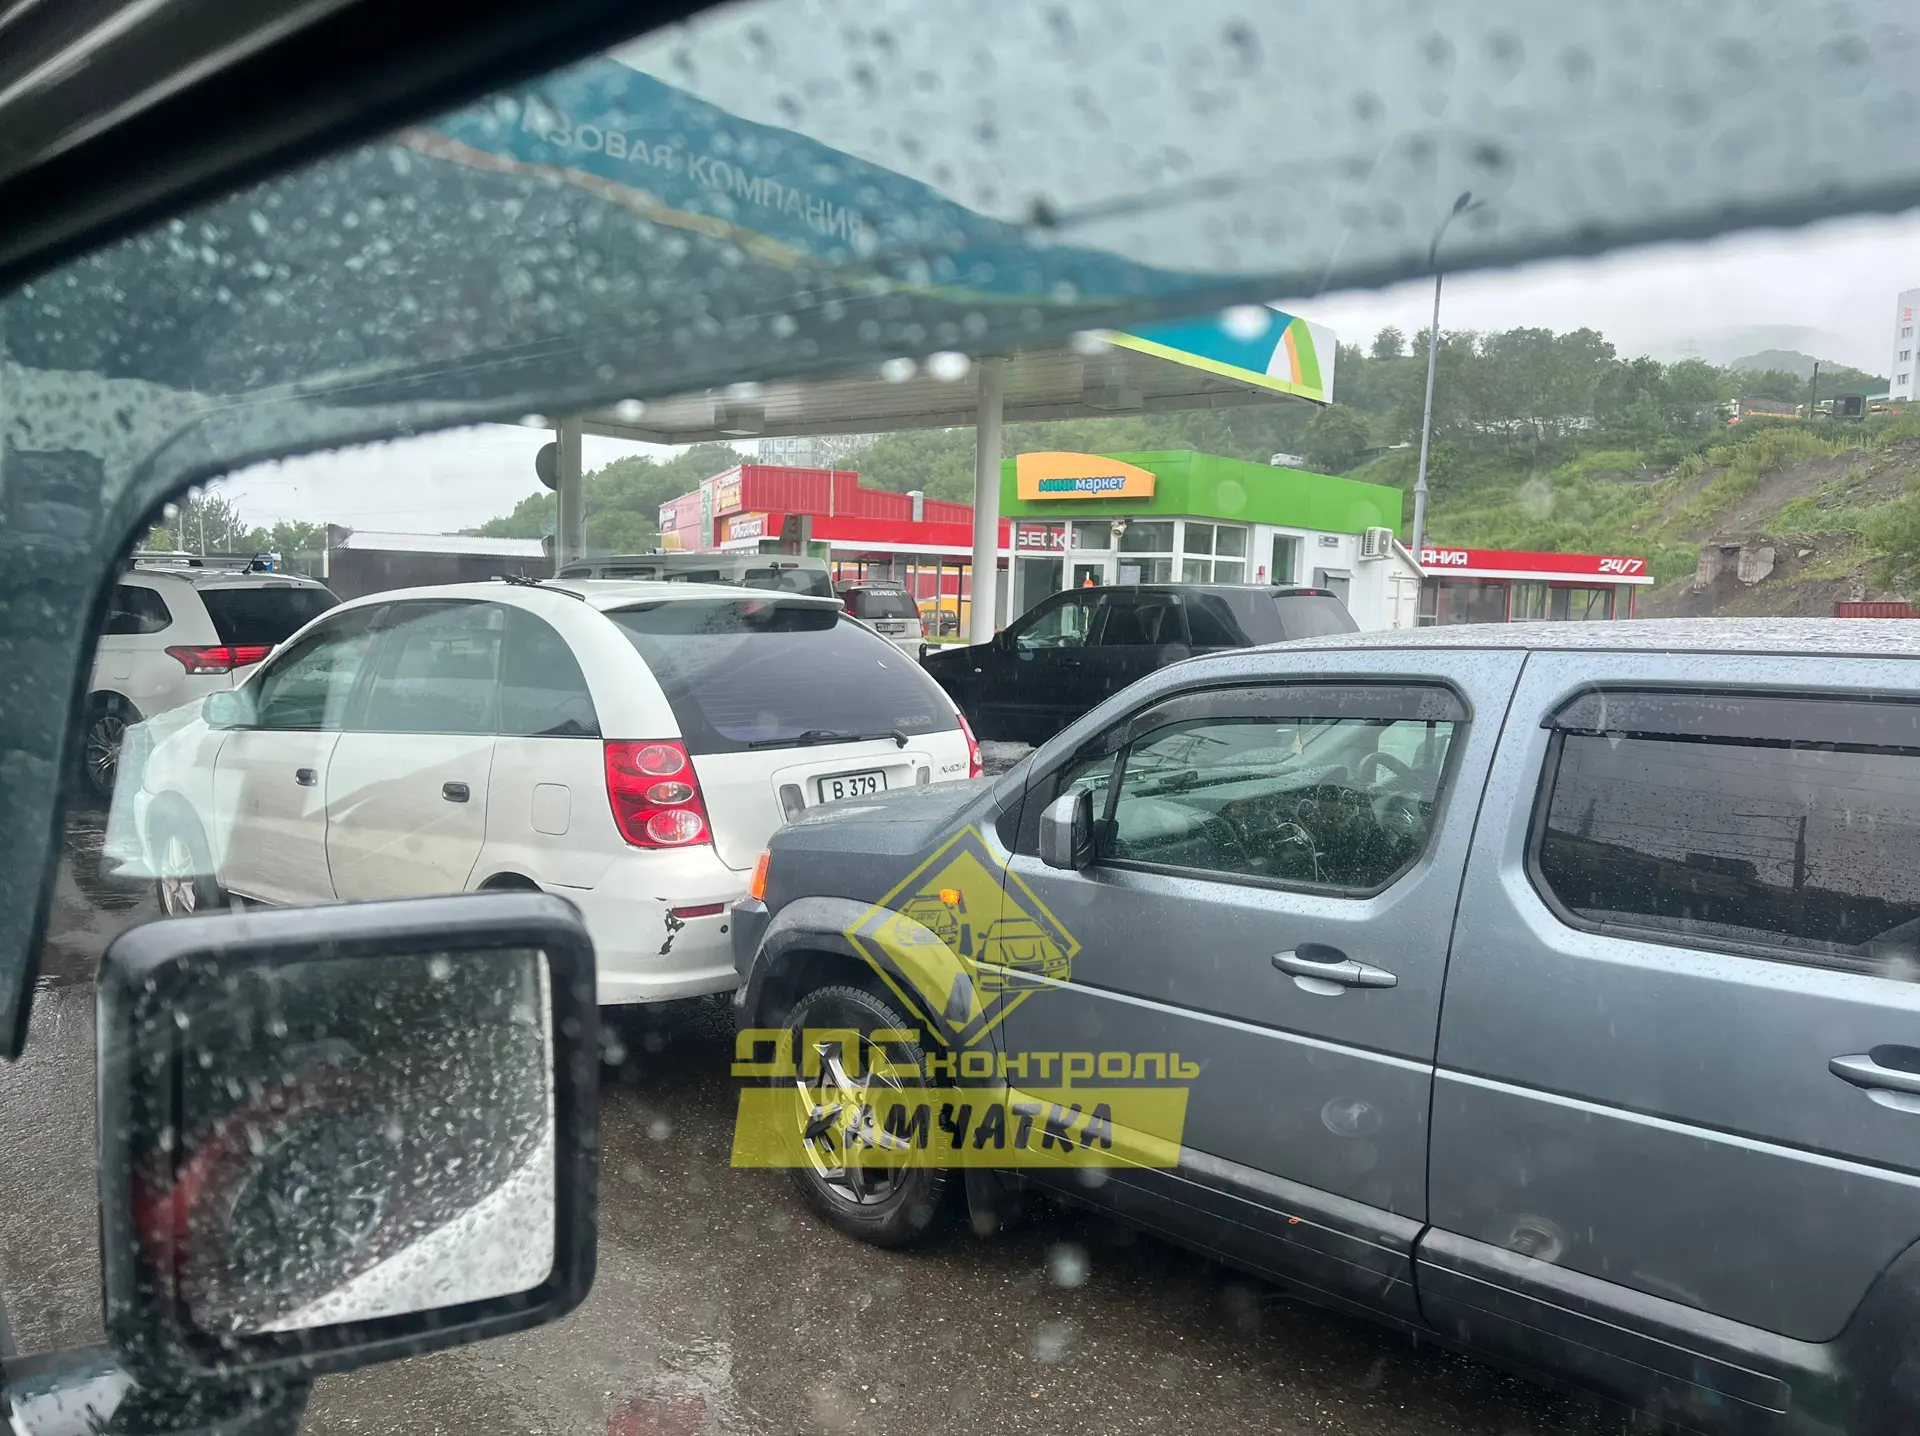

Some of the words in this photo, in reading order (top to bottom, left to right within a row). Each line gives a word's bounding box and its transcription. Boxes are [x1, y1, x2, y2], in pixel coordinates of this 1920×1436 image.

[1039, 476, 1126, 493] минимаркет
[1410, 549, 1468, 565] АНИЯ
[1598, 558, 1643, 573] 24/7
[849, 777, 876, 796] 379
